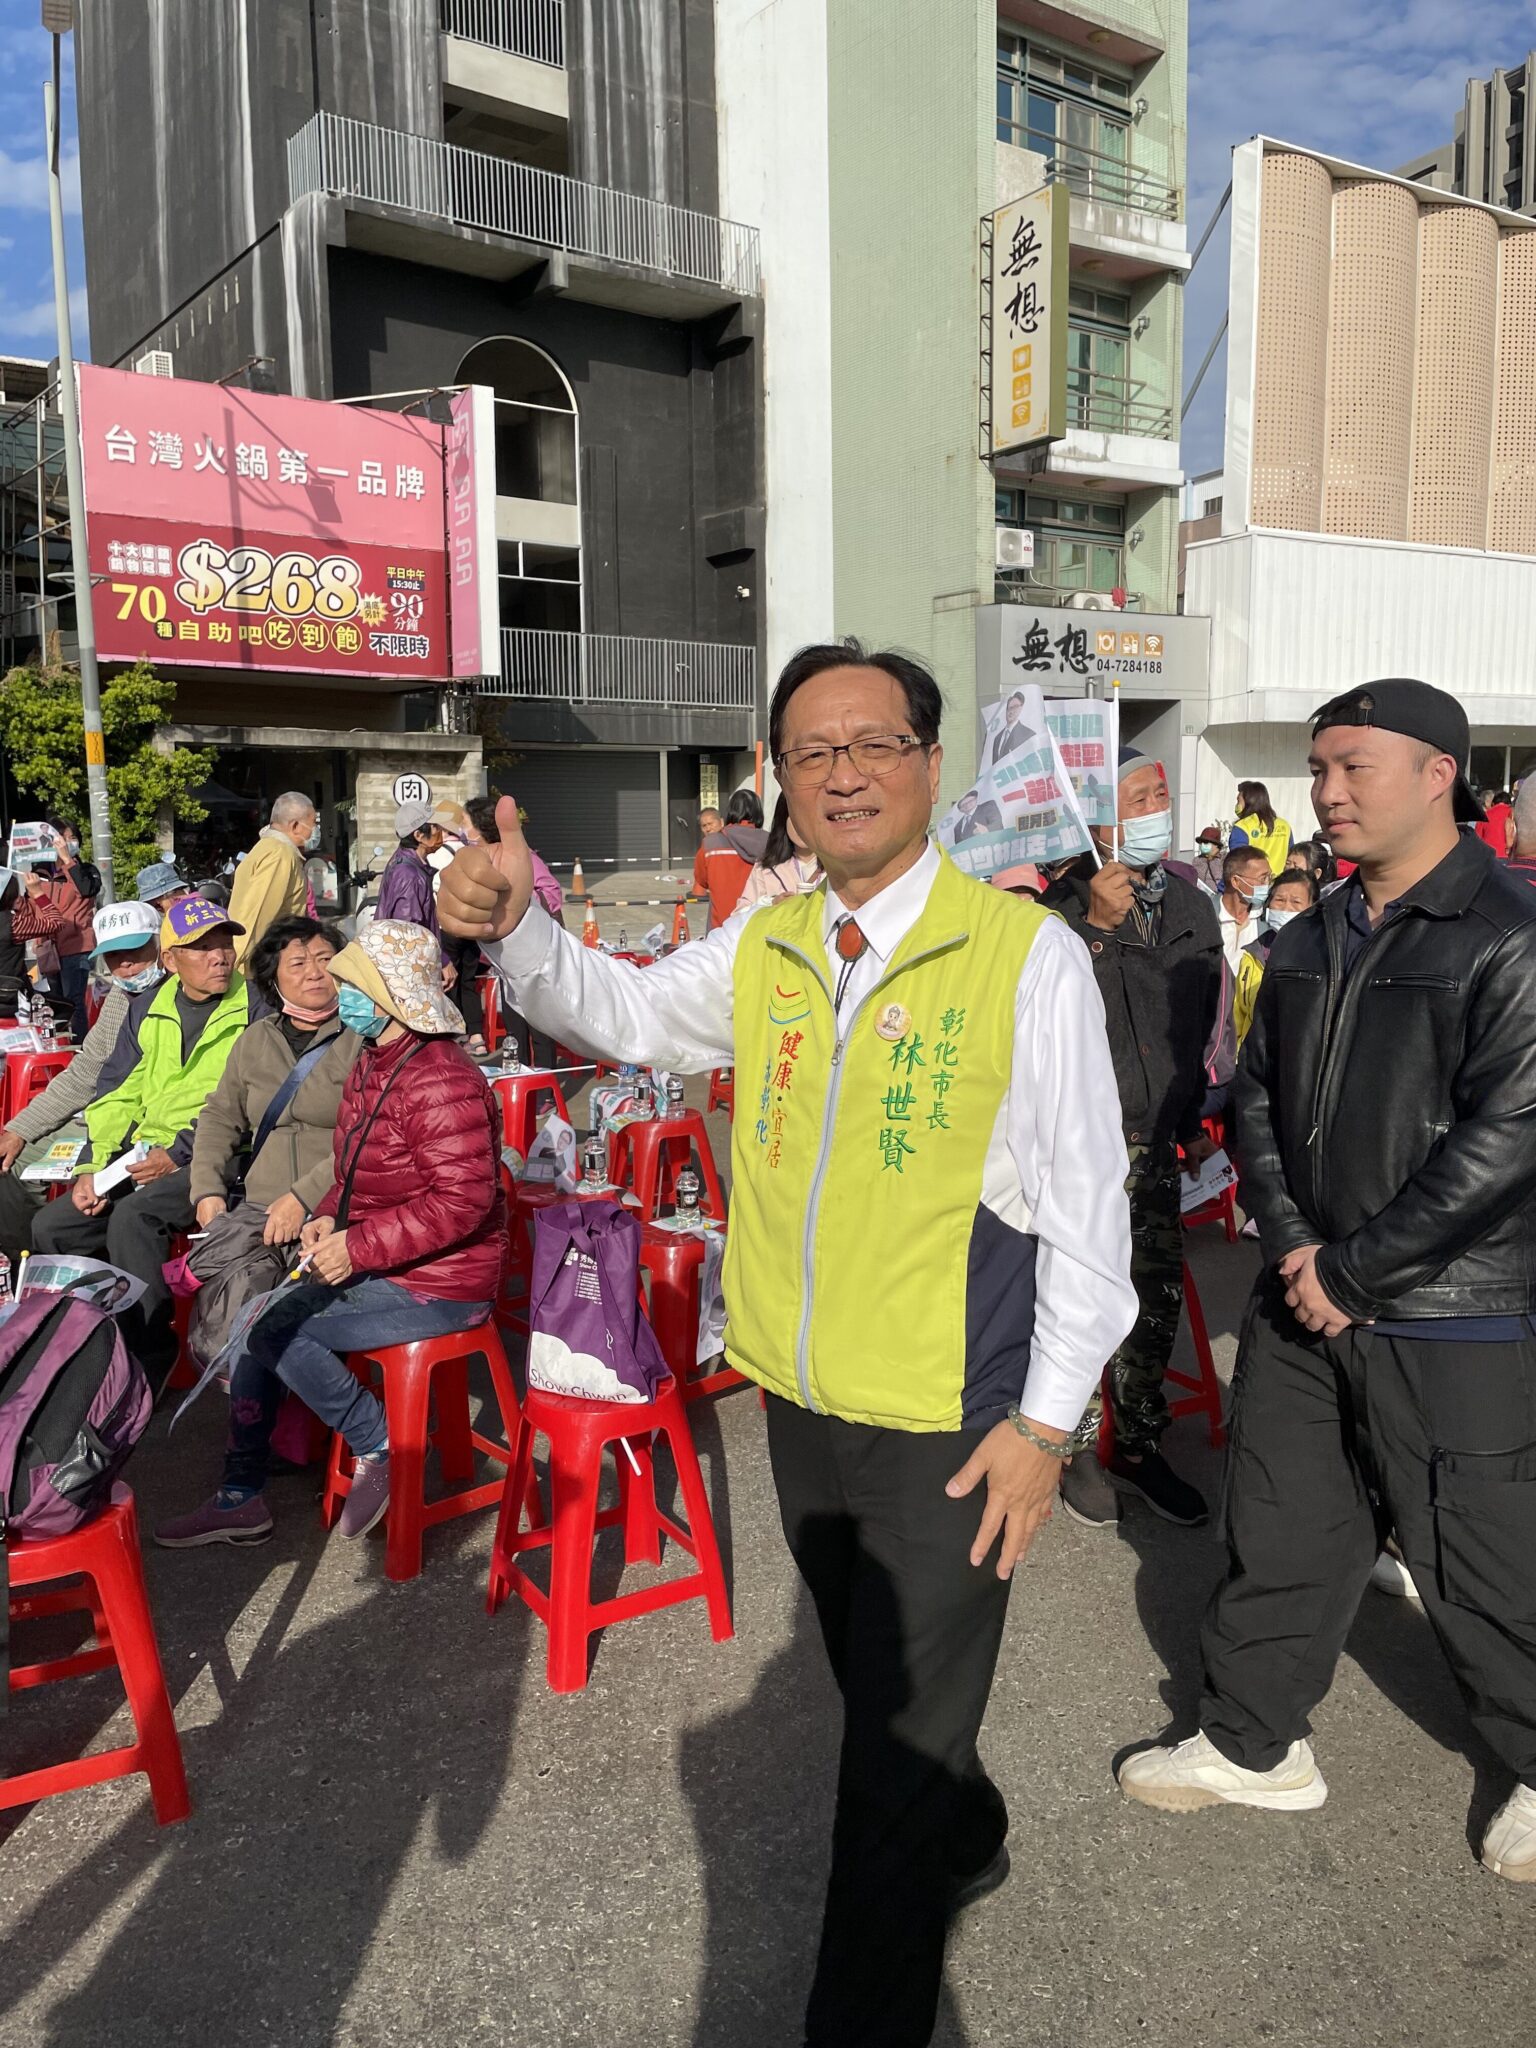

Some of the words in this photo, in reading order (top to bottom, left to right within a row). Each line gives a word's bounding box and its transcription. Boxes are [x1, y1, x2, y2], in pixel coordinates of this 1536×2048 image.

[1001, 215, 1045, 341] 無想
[104, 423, 427, 503] 台灣火鍋第一品牌
[178, 540, 362, 619] $268
[386, 566, 425, 580] 平日中午
[390, 592, 424, 619] 90
[394, 617, 419, 632] 分鐘
[370, 633, 428, 657] 不限時
[1012, 618, 1096, 674] 無想
[1096, 659, 1162, 674] 04-7284188
[926, 1007, 967, 1130] 彰化市長
[879, 1032, 927, 1174] 林世賢
[531, 1368, 567, 1394] Show
